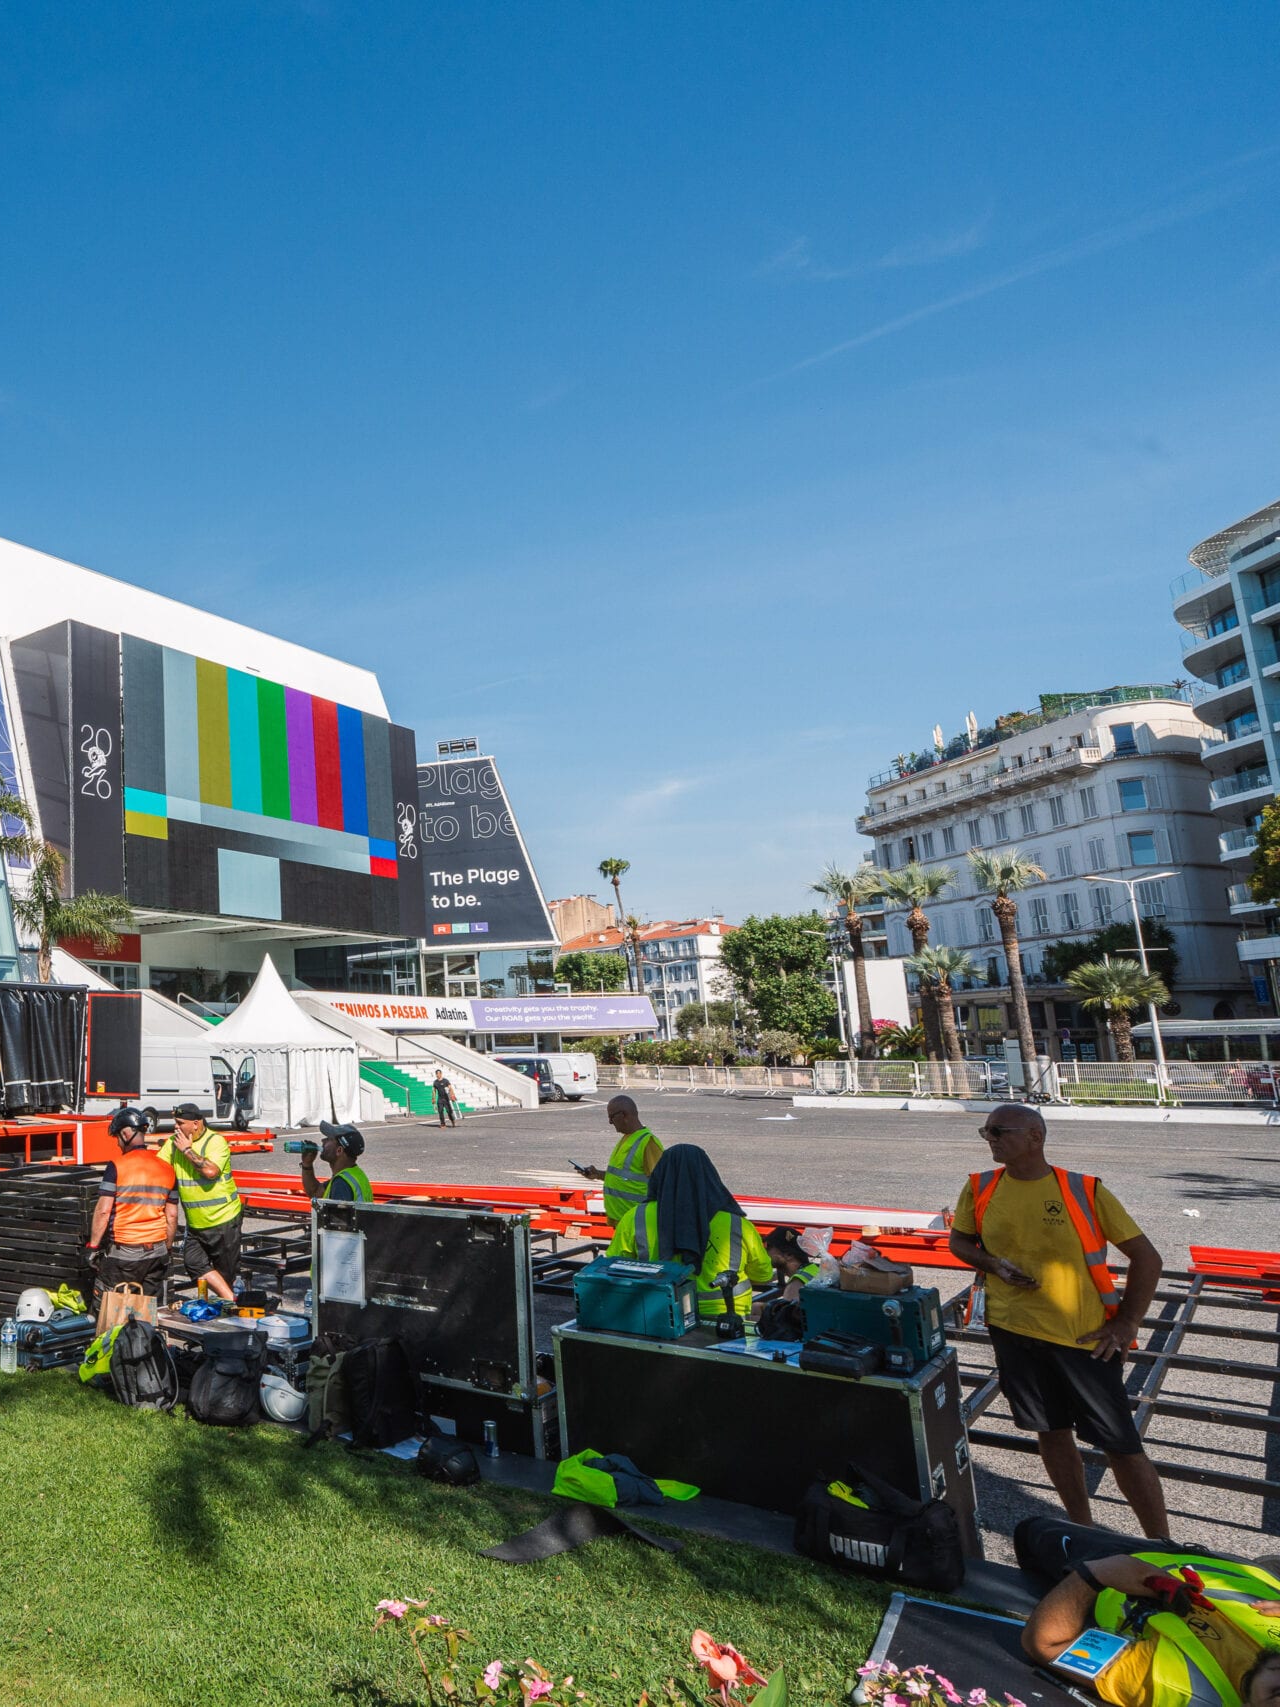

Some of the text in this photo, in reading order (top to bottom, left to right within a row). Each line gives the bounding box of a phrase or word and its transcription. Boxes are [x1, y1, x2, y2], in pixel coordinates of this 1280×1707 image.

[419, 804, 518, 843] to be
[429, 868, 520, 887] The Plage
[431, 892, 482, 909] to be.
[435, 923, 486, 934] RTL
[382, 1005, 392, 1019] A
[391, 1005, 429, 1020] PASEAR
[435, 1007, 468, 1021] Adlatina
[484, 1006, 522, 1014] Creativity
[523, 1006, 540, 1014] gets
[570, 1004, 599, 1013] trophy.
[524, 1015, 541, 1023] gets
[571, 1013, 597, 1022] yacht.
